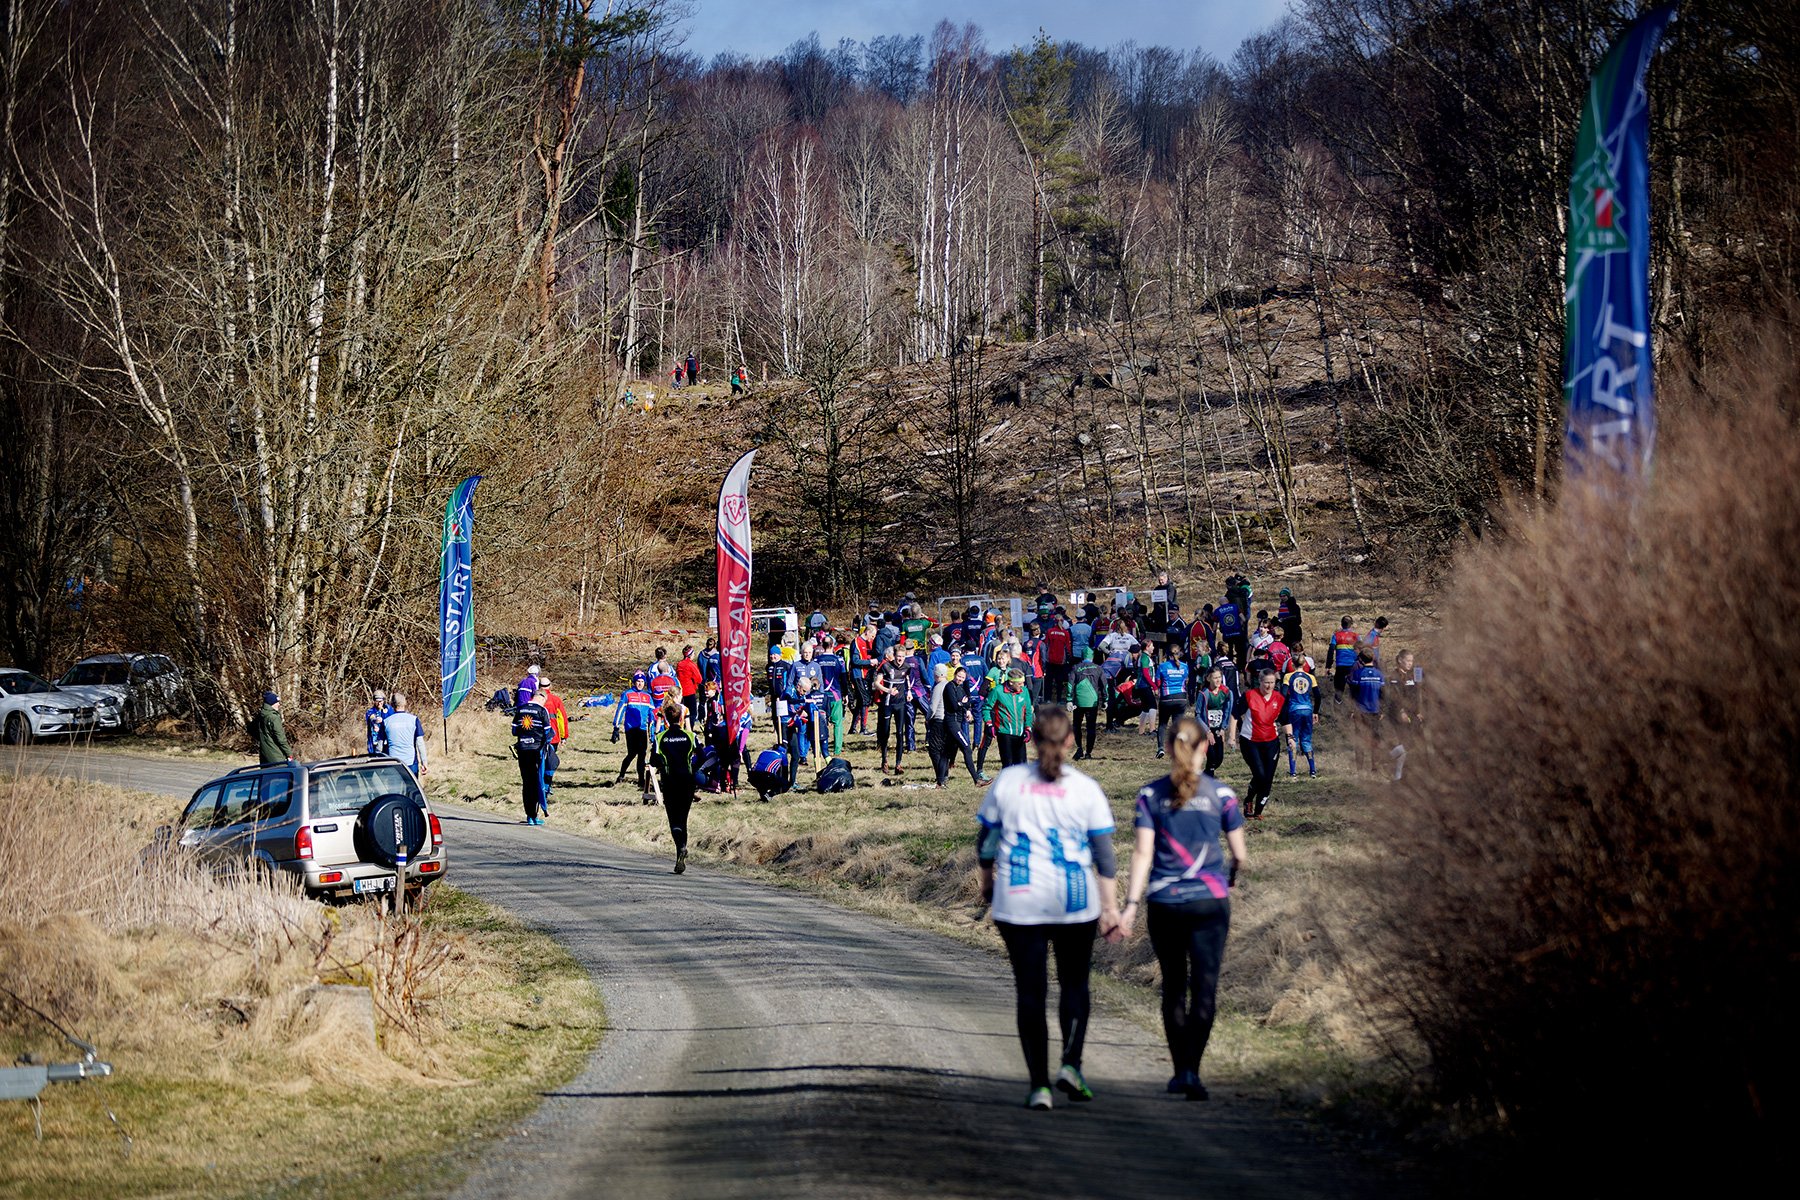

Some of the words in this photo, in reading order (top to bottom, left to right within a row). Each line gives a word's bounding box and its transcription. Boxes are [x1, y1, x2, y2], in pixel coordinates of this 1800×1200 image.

[1591, 303, 1647, 471] ART
[445, 557, 472, 635] START
[728, 580, 748, 624] AIK
